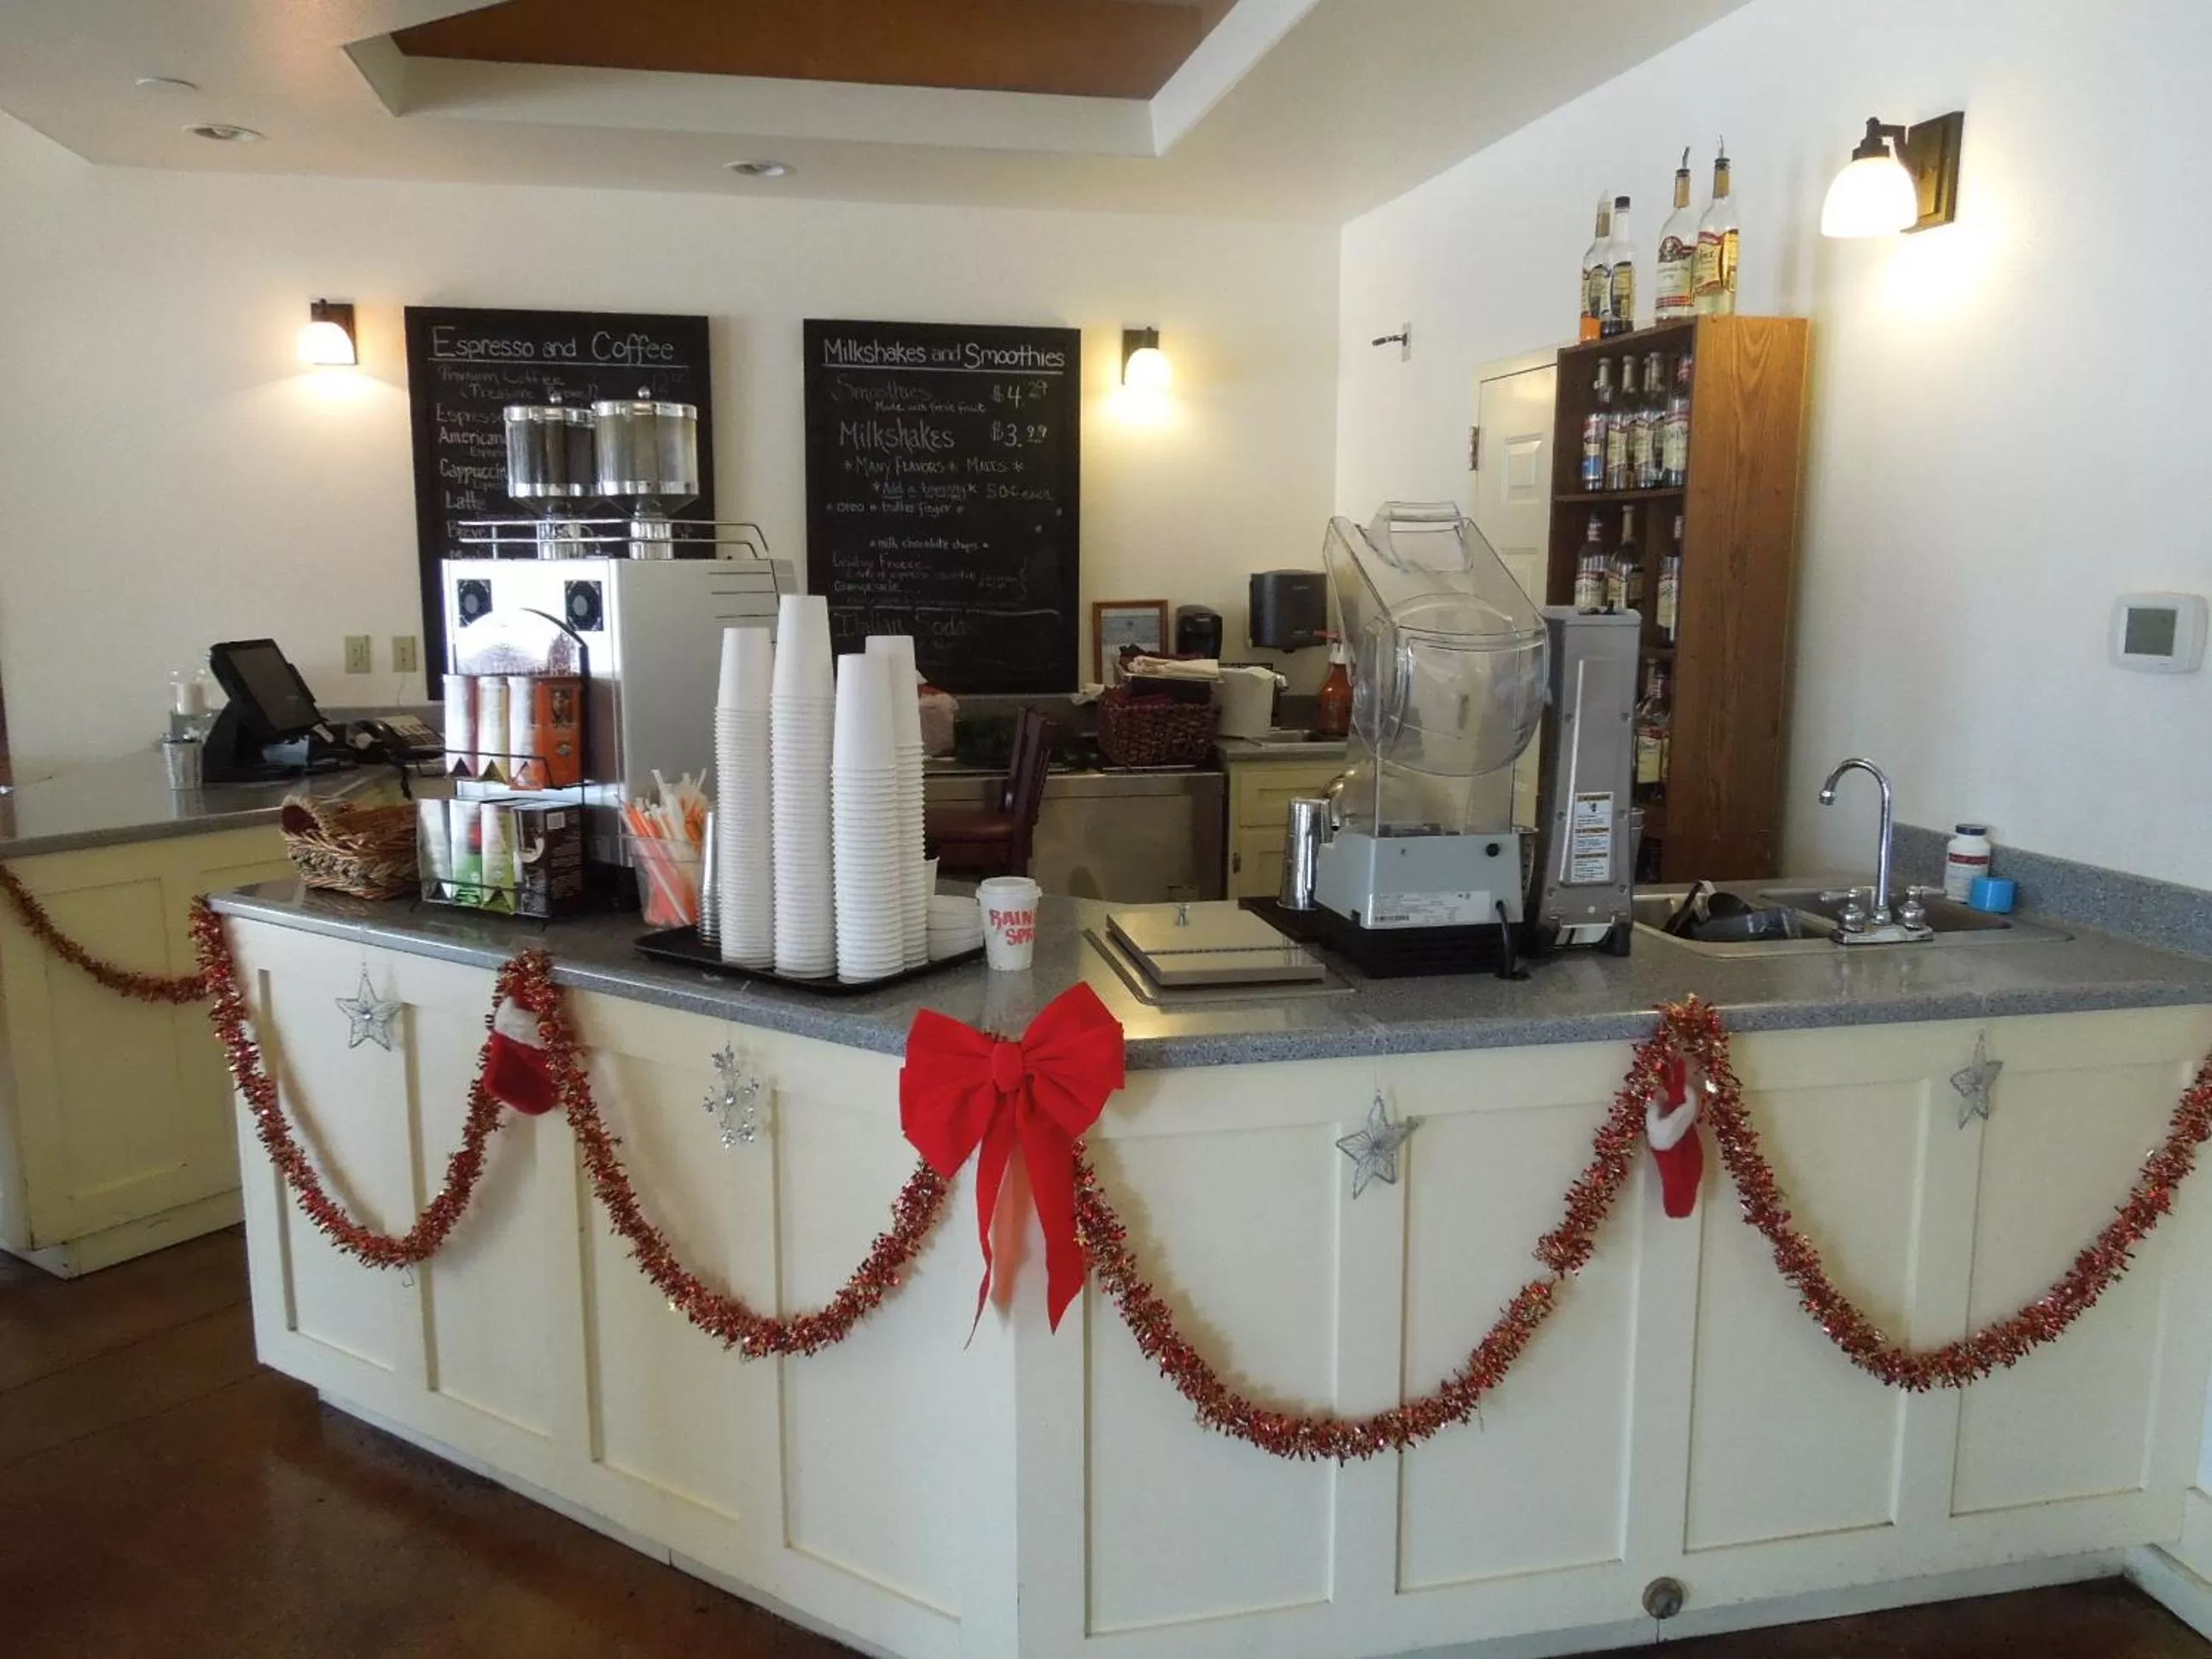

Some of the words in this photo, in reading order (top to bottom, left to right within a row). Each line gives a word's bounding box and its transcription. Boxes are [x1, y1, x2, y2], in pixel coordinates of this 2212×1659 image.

[432, 326, 534, 359] Espresso
[543, 338, 577, 358] and
[591, 331, 674, 365] Coffee
[824, 339, 926, 364] Milkshakes
[932, 344, 961, 361] and
[964, 342, 1065, 369] Smoothies
[439, 426, 507, 445] American
[840, 416, 955, 452] Milkshakes
[989, 908, 1038, 930] RAIN
